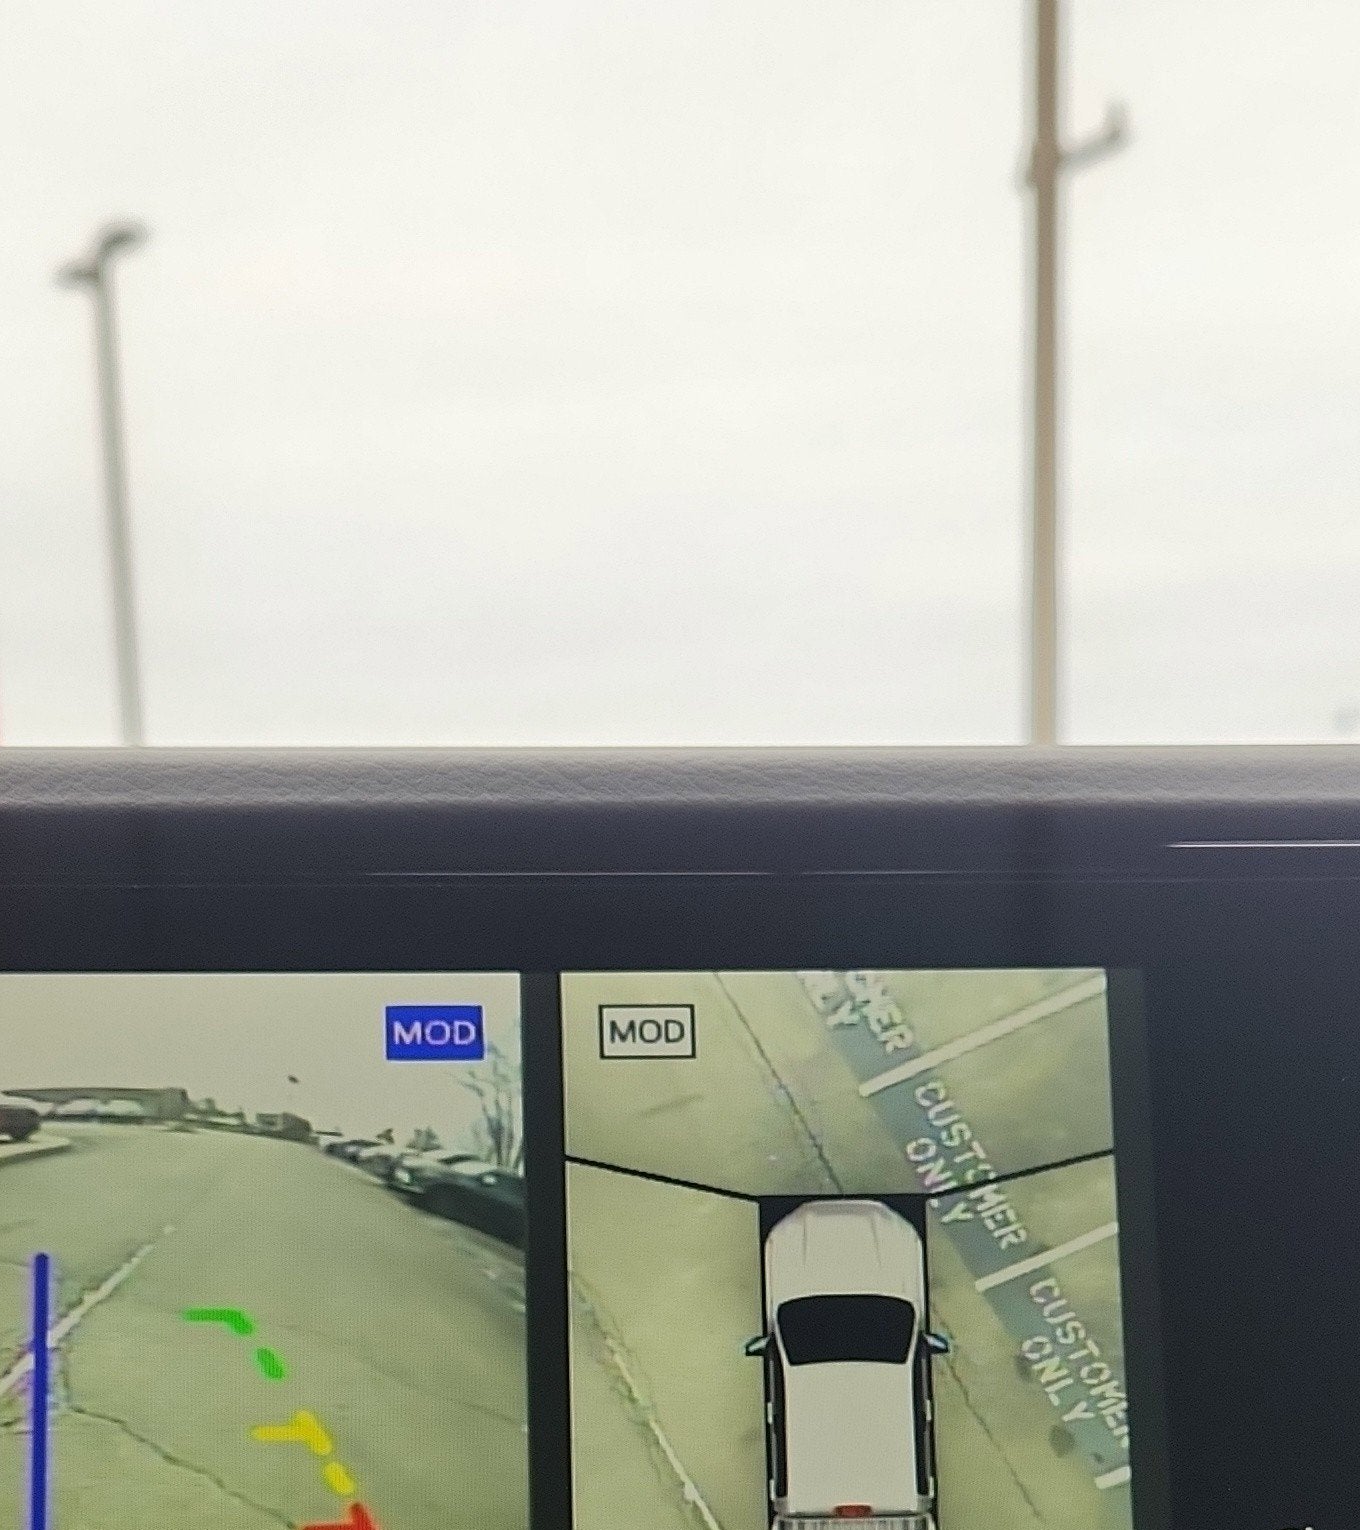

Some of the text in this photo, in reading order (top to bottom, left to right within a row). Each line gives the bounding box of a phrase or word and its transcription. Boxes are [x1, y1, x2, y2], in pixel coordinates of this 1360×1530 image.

[392, 1017, 477, 1048] MOD
[608, 1020, 686, 1045] MOD
[905, 1137, 974, 1226] ONLY
[914, 1080, 1027, 1250] CUSTOMER
[1020, 1335, 1096, 1424] ONLY
